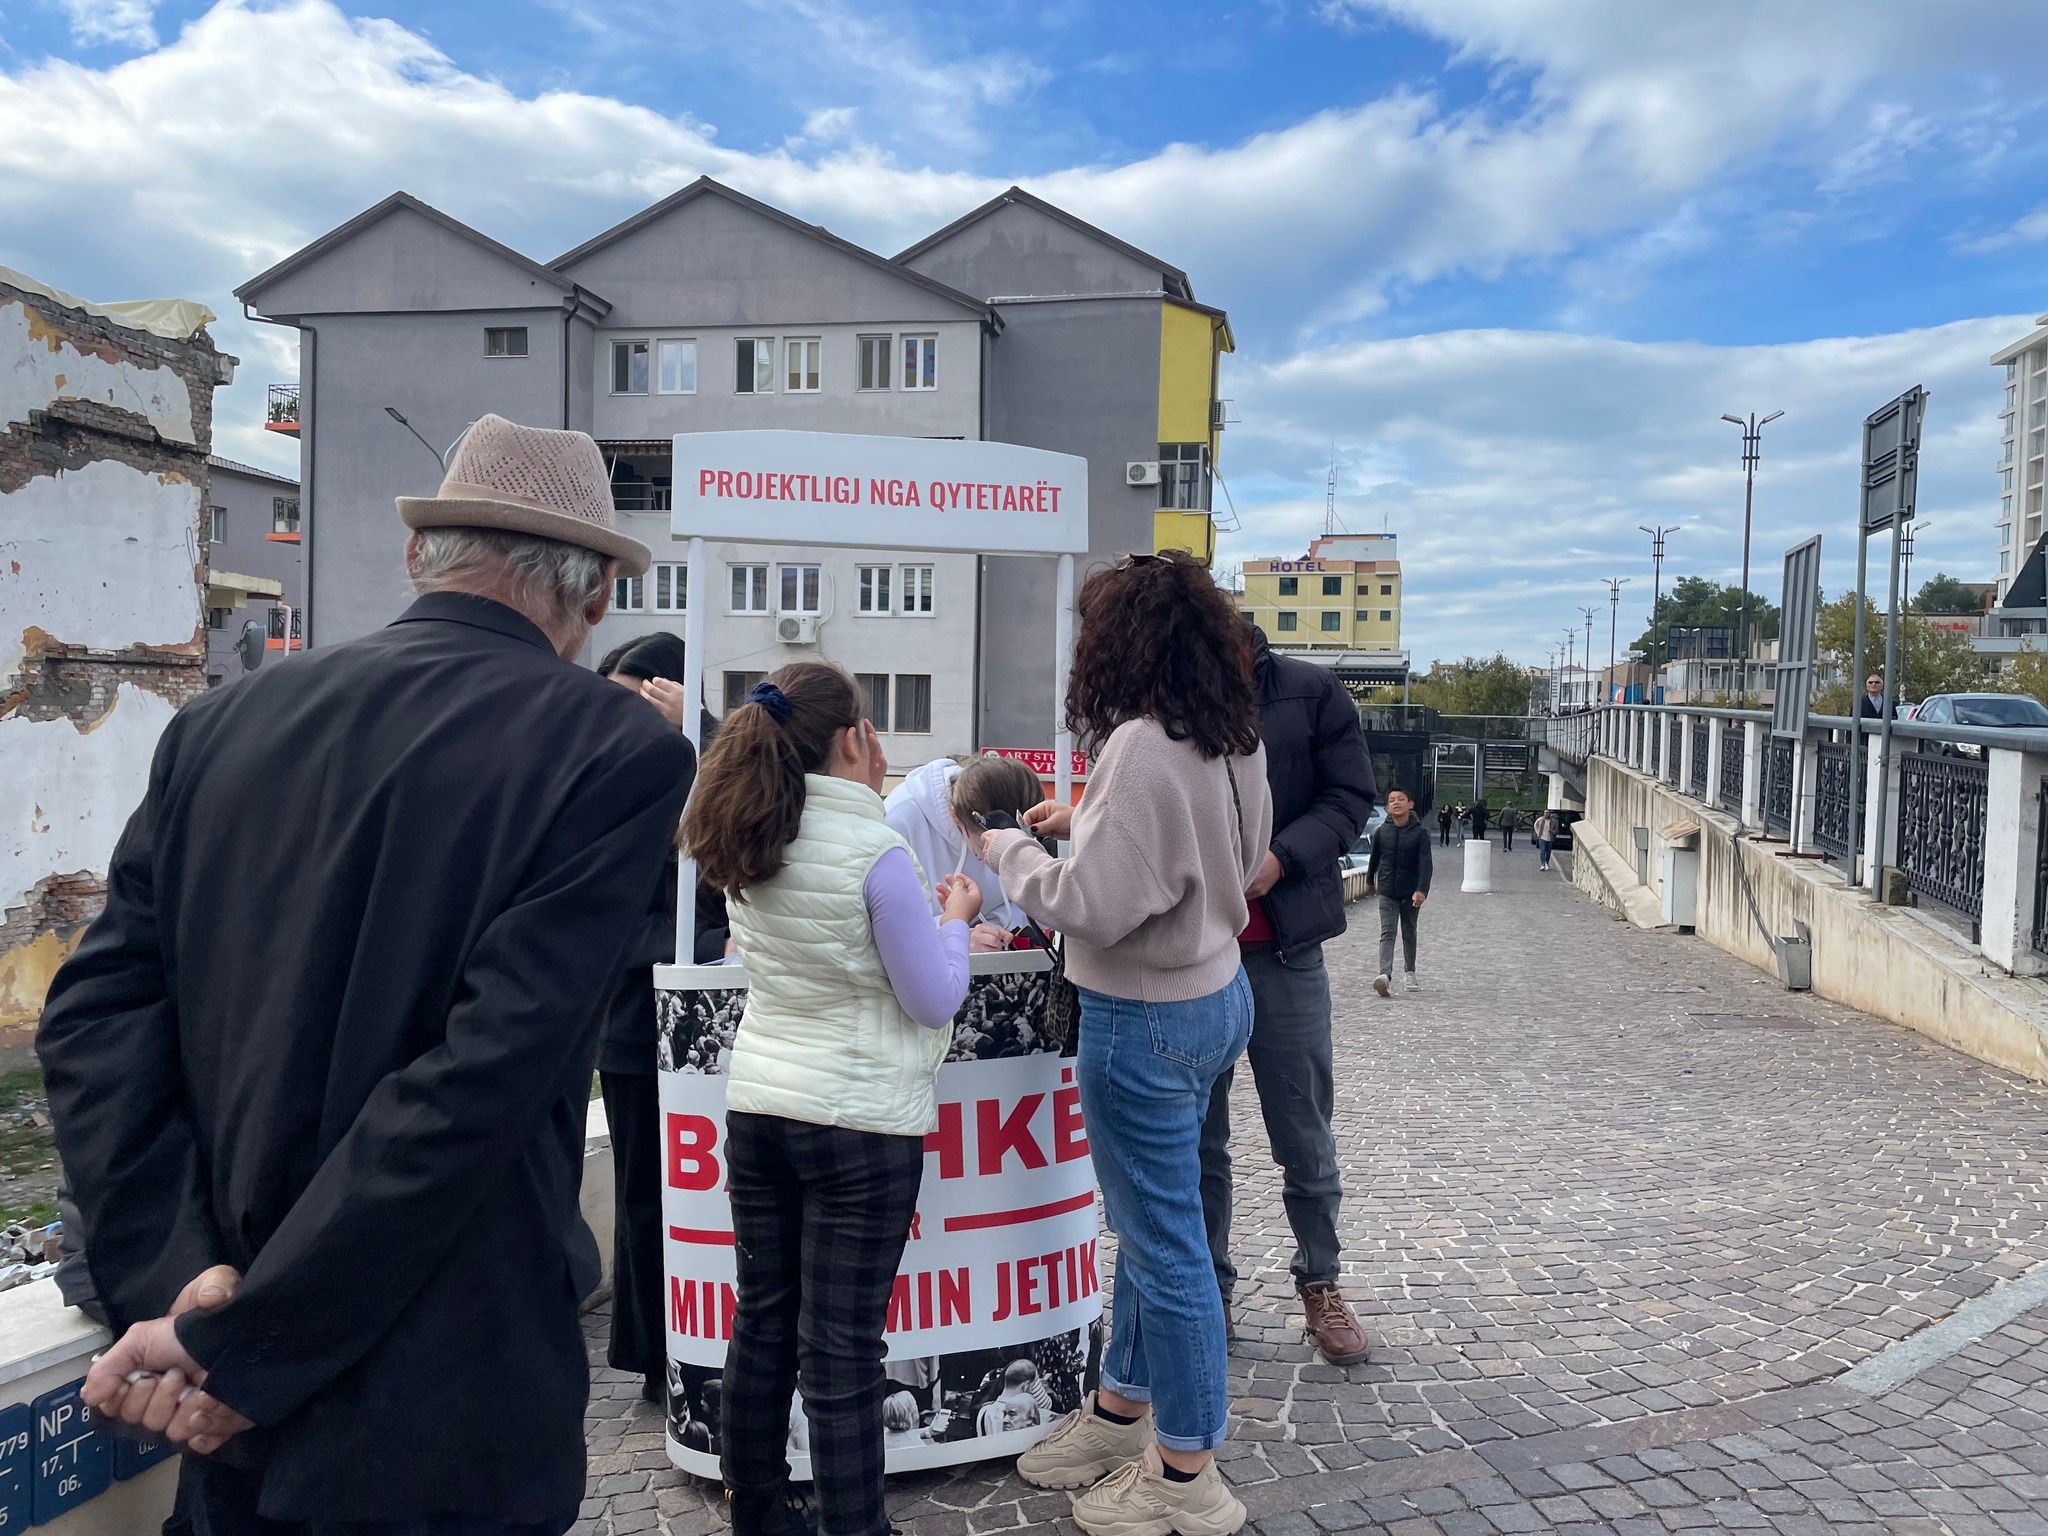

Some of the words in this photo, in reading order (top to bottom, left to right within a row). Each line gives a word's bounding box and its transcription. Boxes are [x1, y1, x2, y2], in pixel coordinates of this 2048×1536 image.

[699, 469, 860, 505] PROJEKTLIGJ
[870, 478, 921, 506] NGA
[929, 480, 1062, 513] QYTETARËT
[1270, 561, 1326, 573] HOTEL
[1033, 752, 1084, 763] STUO
[992, 1238, 1099, 1322] JETIK
[40, 1404, 73, 1442] NP
